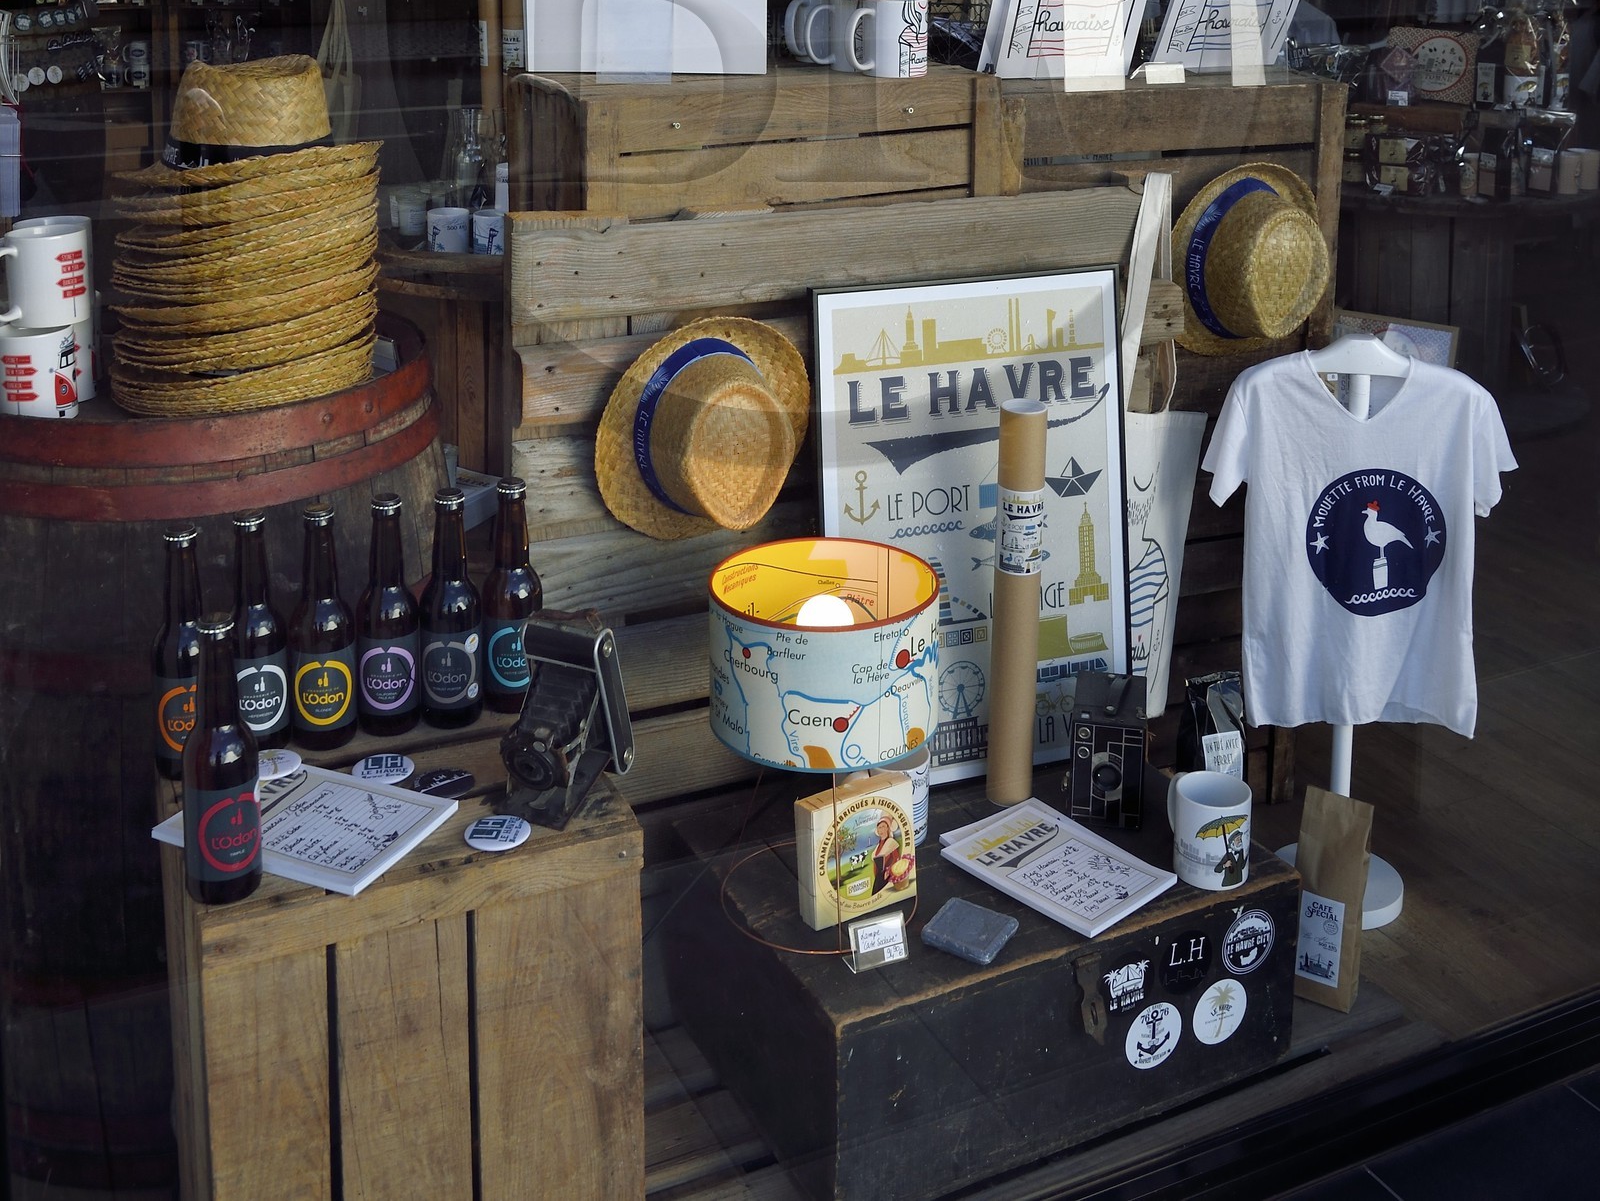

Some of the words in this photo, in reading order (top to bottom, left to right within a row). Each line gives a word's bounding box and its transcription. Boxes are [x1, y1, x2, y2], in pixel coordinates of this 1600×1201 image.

[1034, 10, 1113, 32] havraise
[846, 375, 907, 426] LE
[927, 355, 1096, 419] HAVRE
[887, 493, 904, 522] LE
[912, 484, 971, 514] PORT
[1003, 502, 1014, 512] LE
[1313, 481, 1353, 528] MOUETTE
[1354, 474, 1385, 489] FROM
[1389, 475, 1406, 491] LE
[1407, 485, 1436, 525] HAVRE
[722, 563, 759, 585] Constructions
[846, 593, 875, 607] Plâtre
[776, 631, 792, 644] Pte
[795, 634, 809, 646] de
[911, 636, 925, 658] Le
[766, 647, 807, 661] Barfleur
[723, 650, 779, 685] Cherbourg
[852, 663, 873, 676] Cap
[876, 661, 888, 672] de
[366, 678, 407, 690] L'Odon
[427, 670, 467, 684] L'Odon
[853, 674, 863, 685] la
[867, 671, 890, 684] Hève
[239, 696, 282, 712] L'Odon
[302, 692, 344, 706] L'Odon
[167, 719, 196, 733] L'Od
[721, 713, 744, 735] Malo
[787, 709, 833, 728] Caen
[1038, 715, 1055, 744] LA
[788, 730, 800, 753] Vire
[1226, 738, 1239, 750] AVEC
[366, 755, 403, 770] LH
[376, 767, 409, 775] HAVRE
[433, 774, 447, 782] LH
[211, 827, 259, 849] L'Odon
[819, 830, 834, 877] CARAMELS
[871, 796, 876, 806] À
[877, 799, 910, 848] ISIGNY-SUR-MER
[976, 850, 1003, 867] LE
[1001, 822, 1056, 856] HAVRE
[861, 929, 881, 941] Lampe
[1227, 943, 1235, 955] LE
[1235, 937, 1255, 953] HAVRE
[1255, 932, 1270, 946] CITY
[1169, 936, 1206, 966] L.H
[1109, 998, 1118, 1011] LE
[1119, 989, 1145, 1008] HAVRE
[1140, 1014, 1150, 1024] 76
[1159, 1006, 1170, 1017] 76
